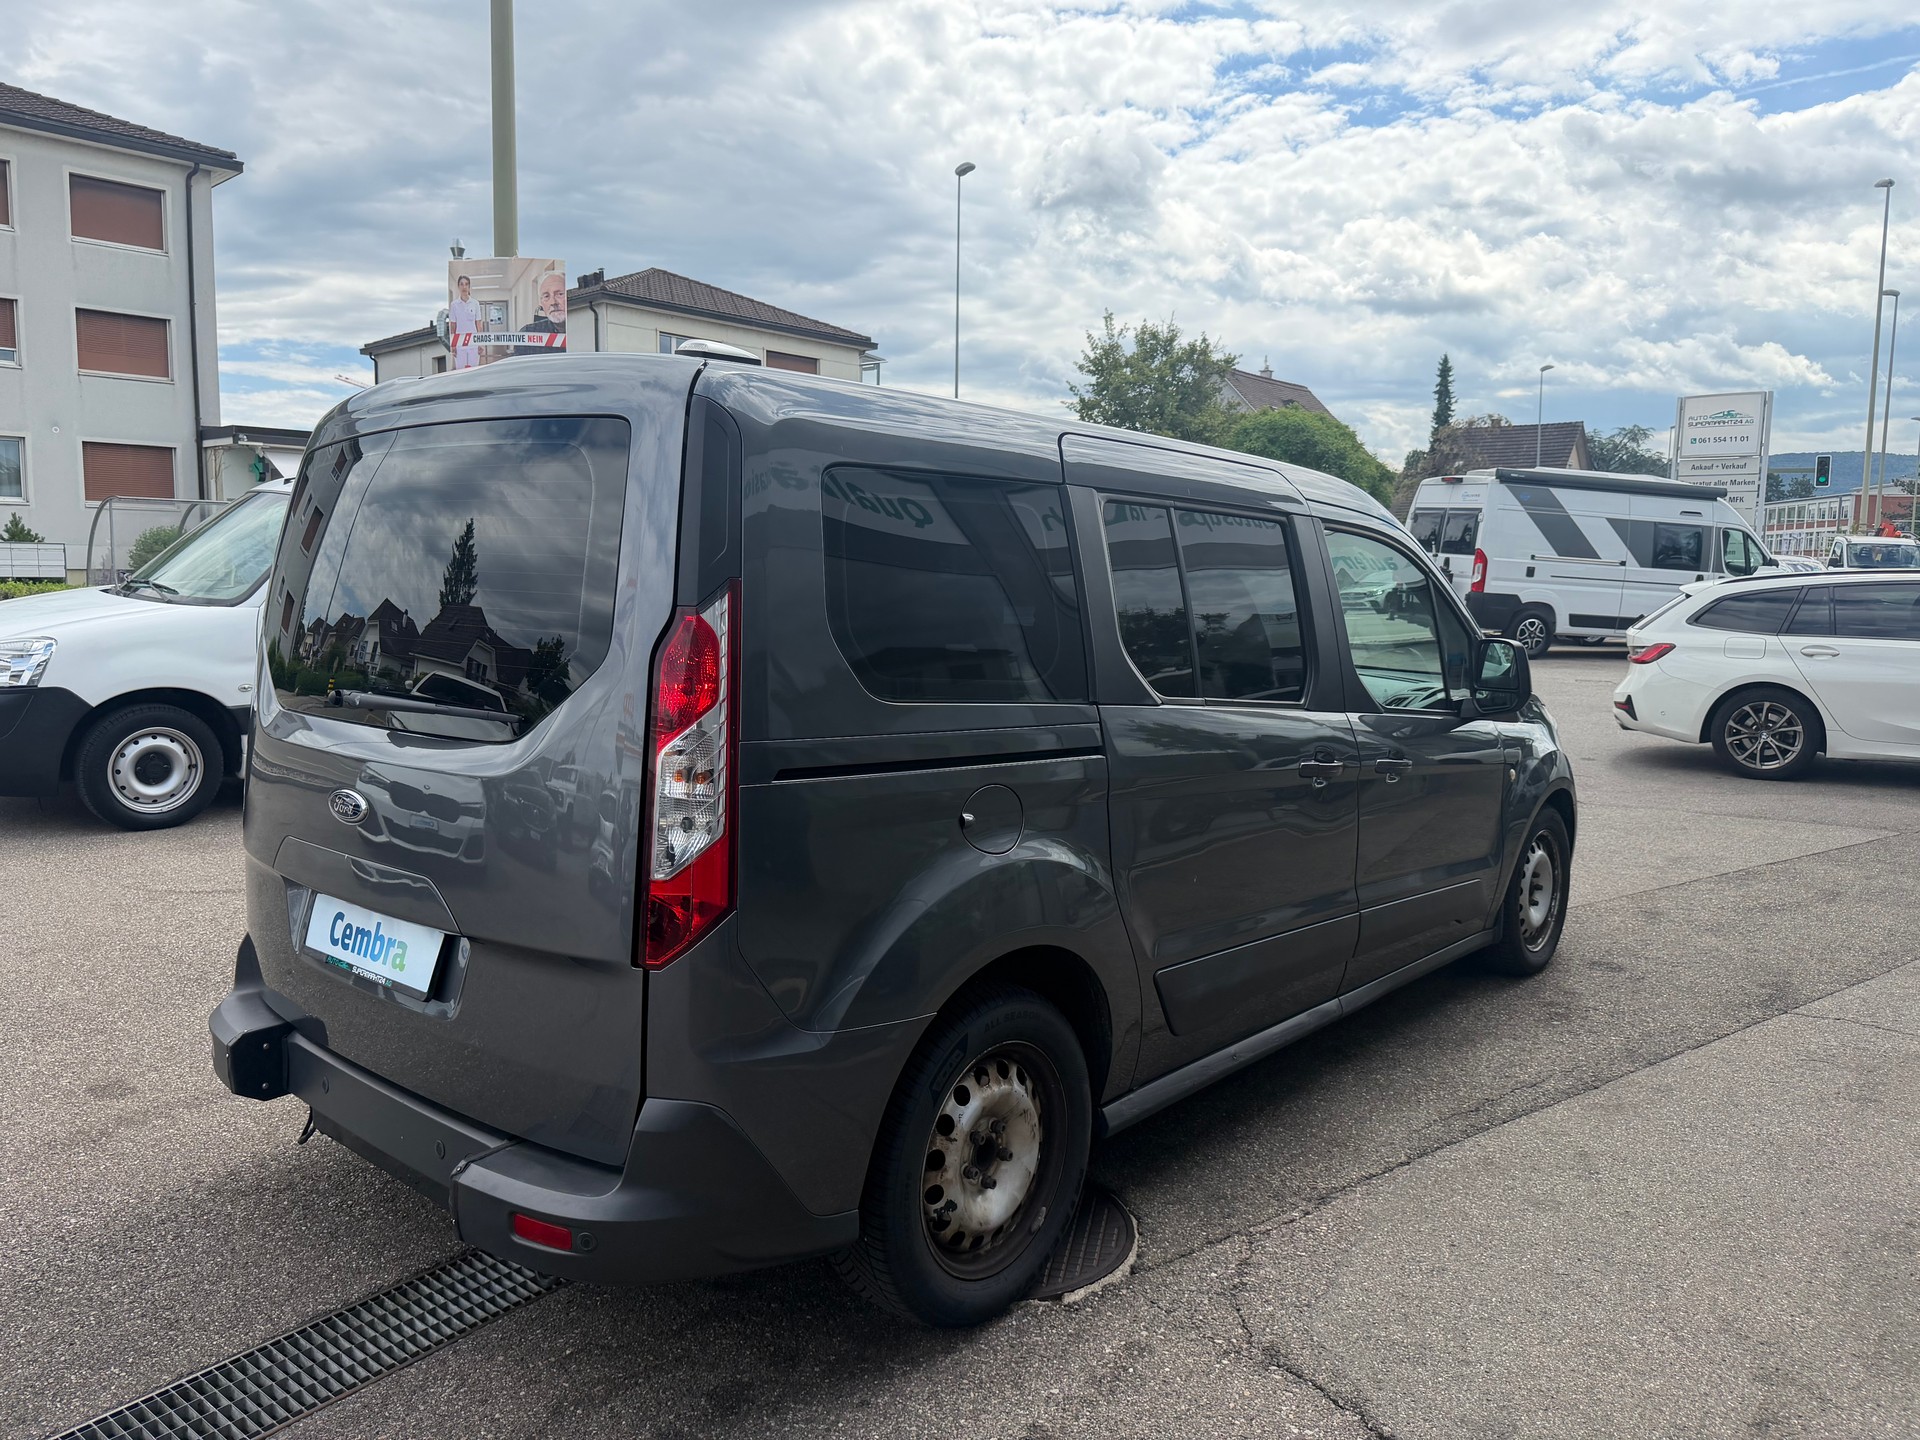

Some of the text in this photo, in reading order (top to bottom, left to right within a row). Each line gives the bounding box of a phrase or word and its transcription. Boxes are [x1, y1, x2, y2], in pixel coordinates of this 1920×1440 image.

[473, 334, 526, 343] CHAOS-INITIATIVE
[527, 334, 543, 343] NEIN
[1690, 463, 1714, 471] Ankauf
[1721, 462, 1747, 470] Verkauf
[1713, 479, 1728, 487] aller
[329, 911, 409, 973] Cembra
